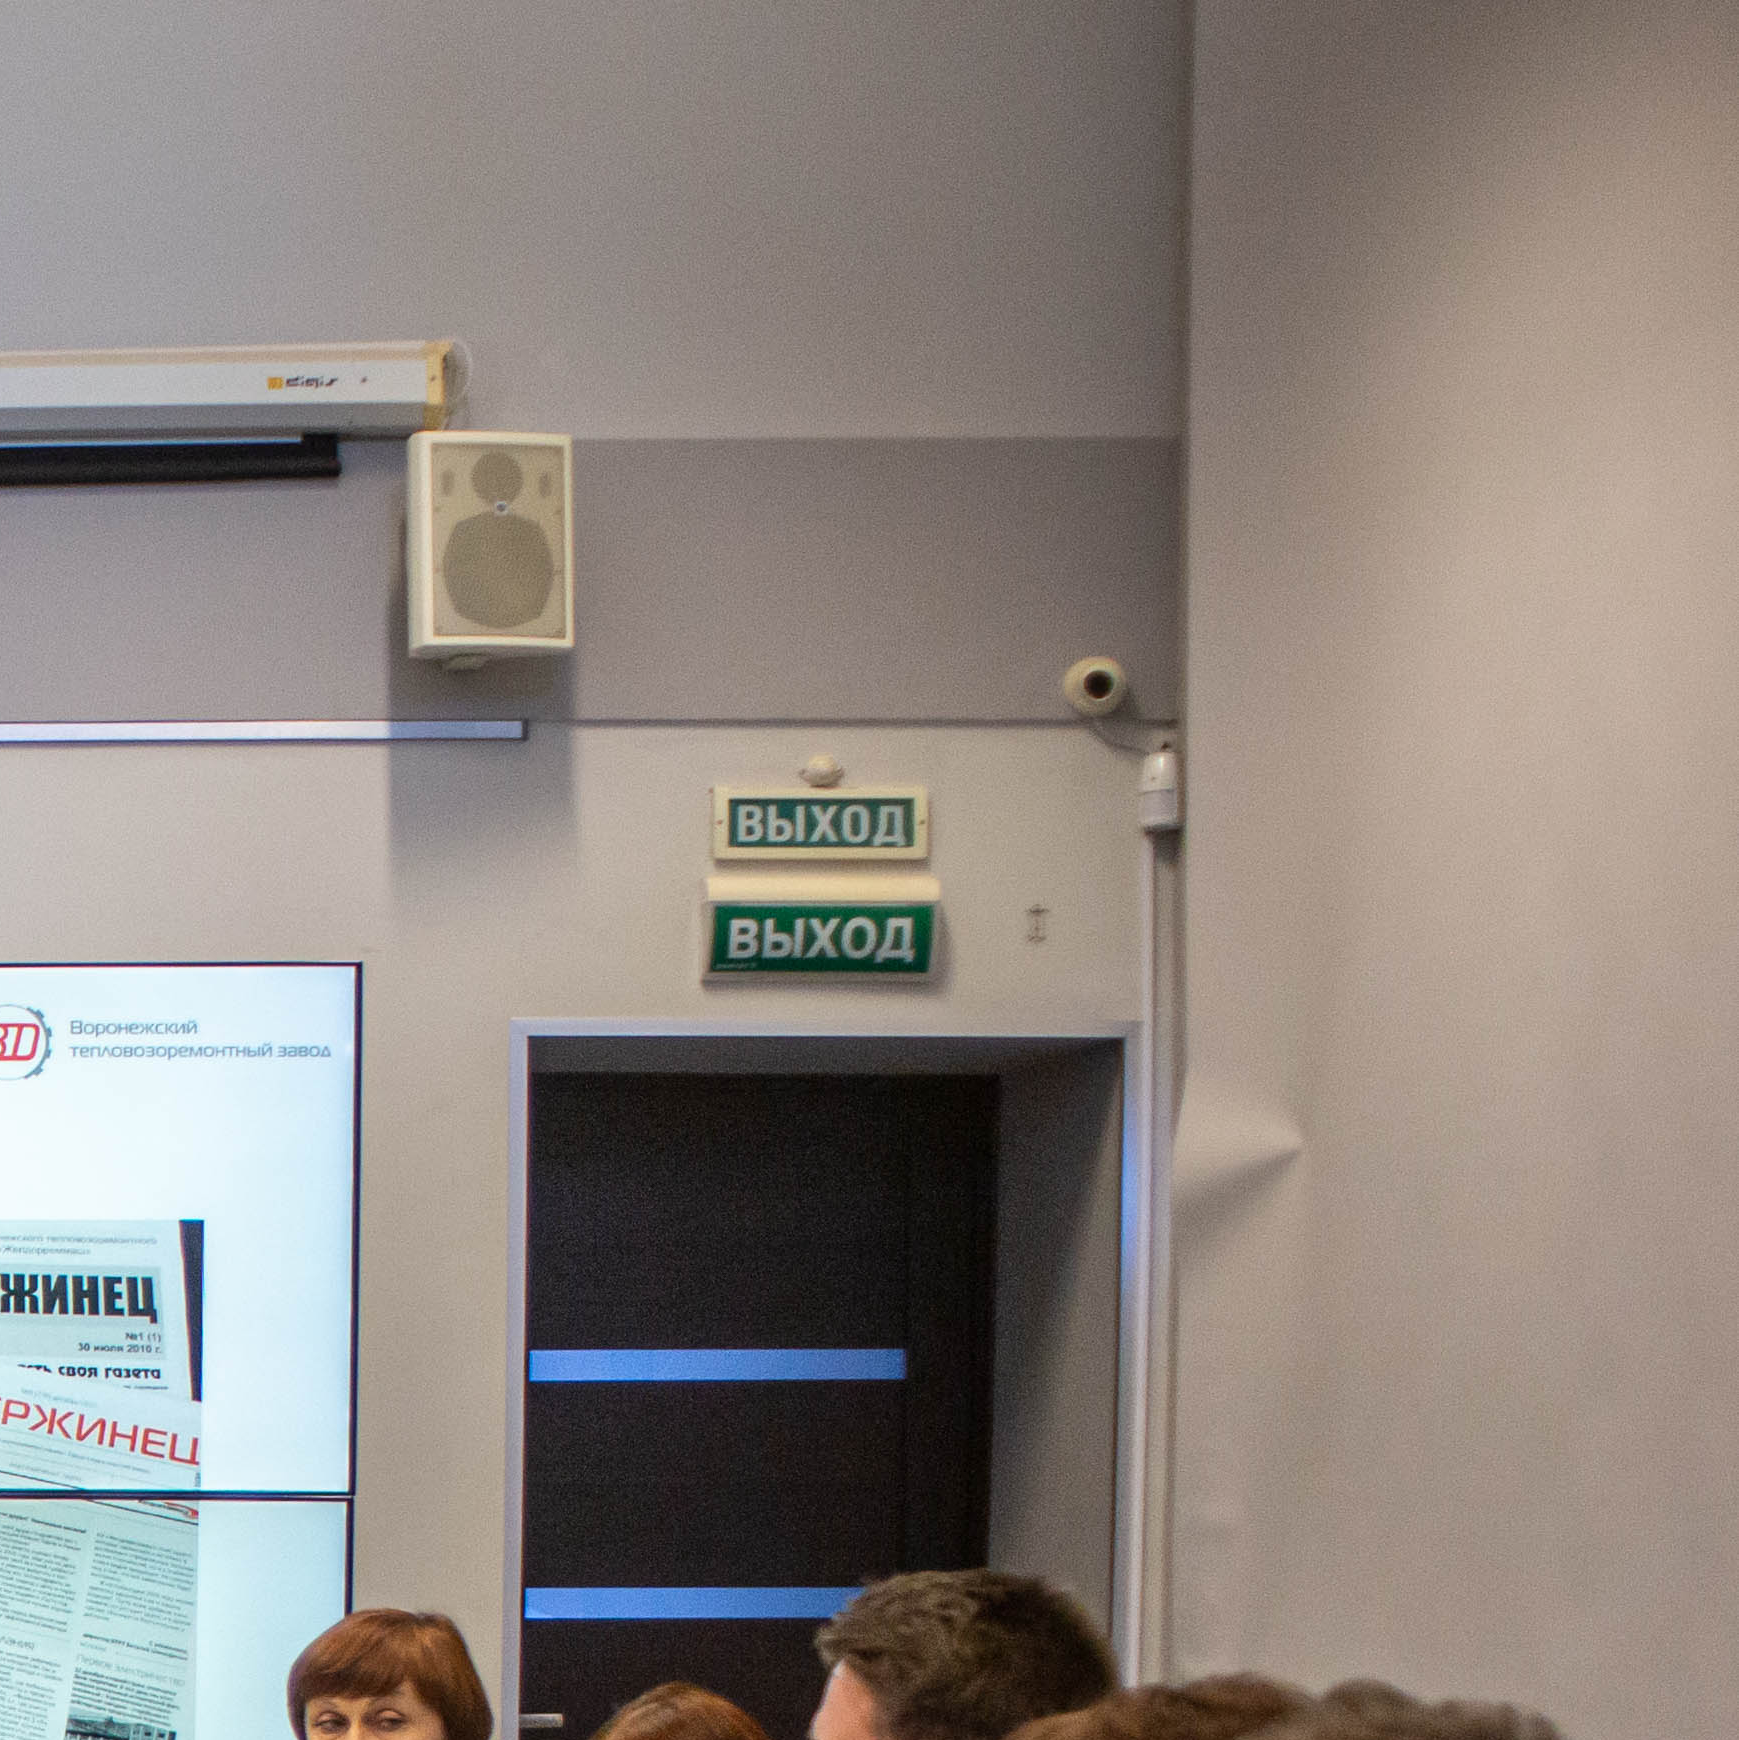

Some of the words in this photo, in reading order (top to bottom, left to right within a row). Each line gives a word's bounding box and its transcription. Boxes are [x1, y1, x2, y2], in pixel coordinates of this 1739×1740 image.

[736, 804, 907, 847] ВЫХОД
[726, 917, 916, 963] ВЫХОД
[70, 1020, 198, 1037] Воронежский
[70, 1043, 273, 1060] тепловозоремонтный
[276, 1044, 332, 1059] завод
[58, 1365, 98, 1379] своя
[104, 1367, 162, 1380] газета
